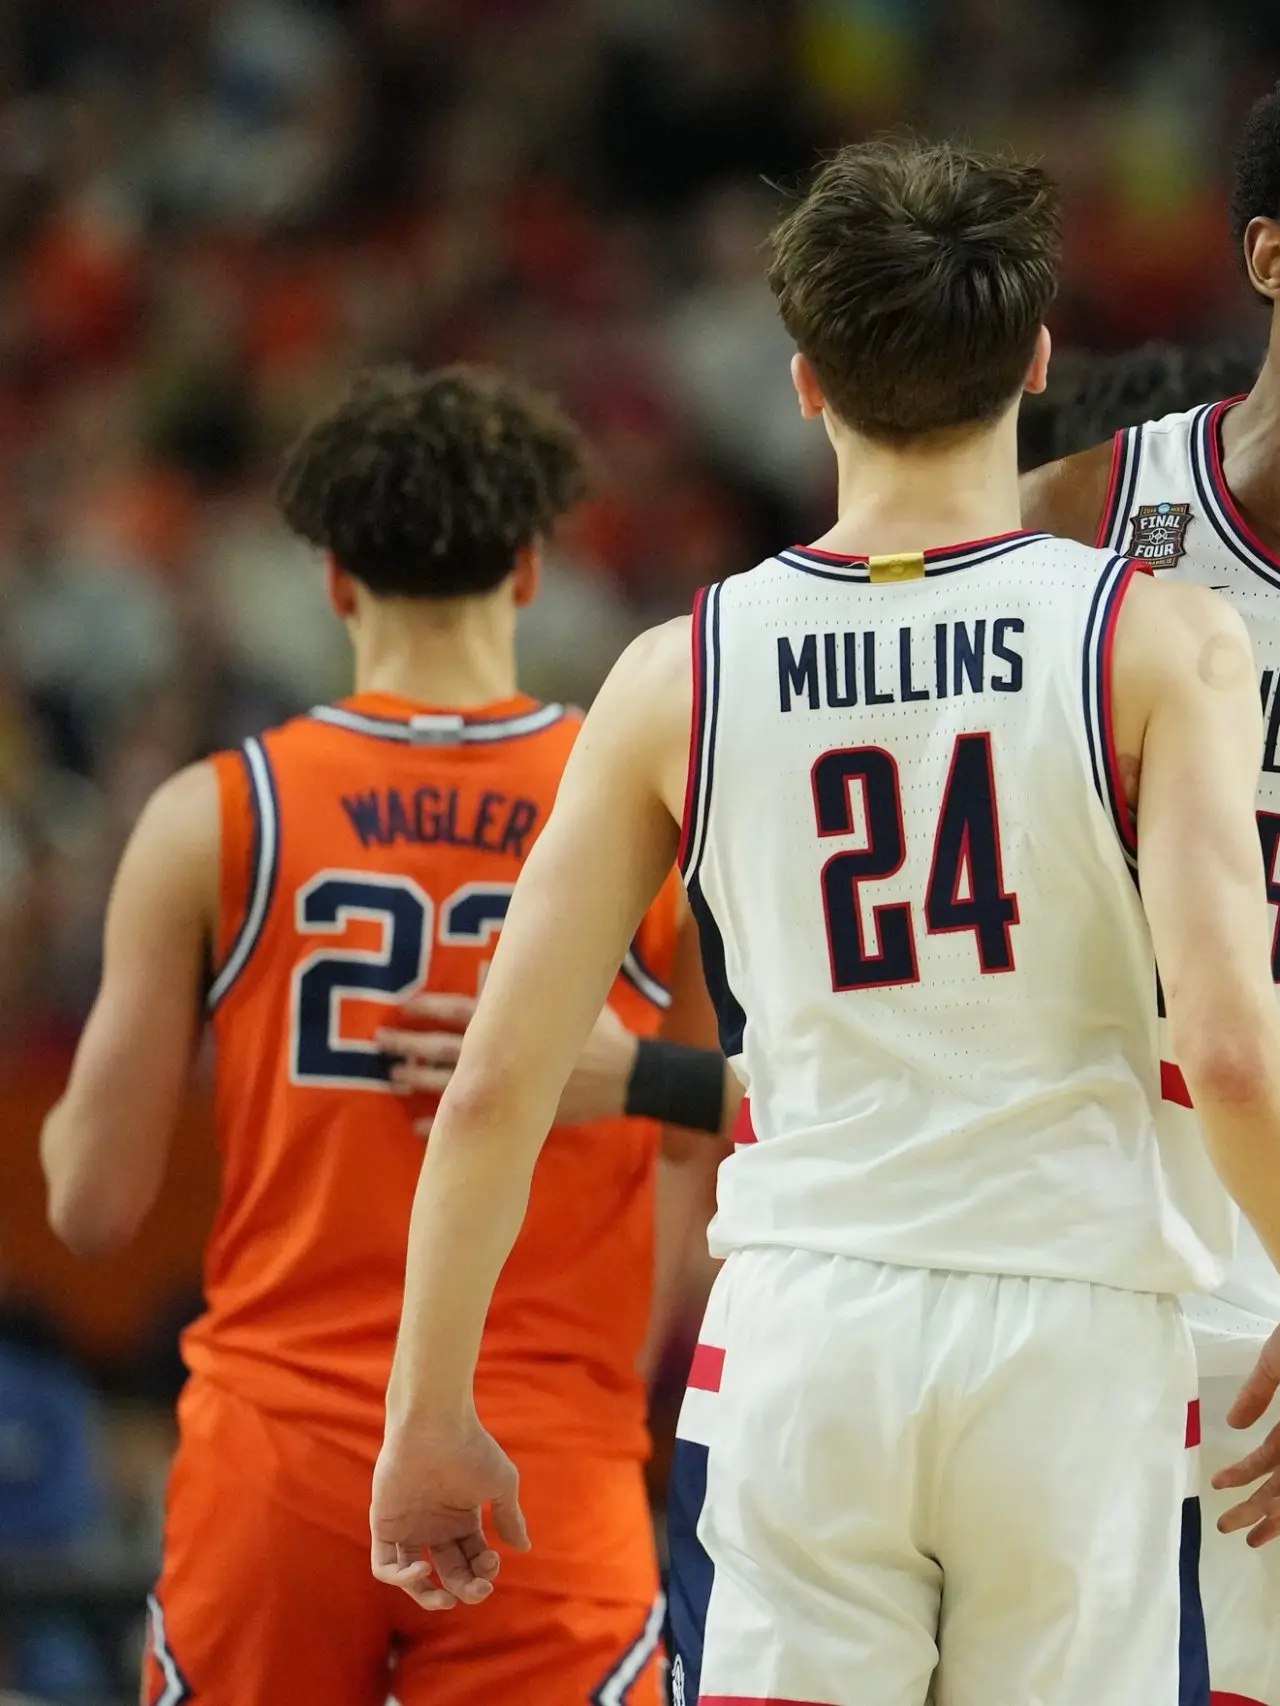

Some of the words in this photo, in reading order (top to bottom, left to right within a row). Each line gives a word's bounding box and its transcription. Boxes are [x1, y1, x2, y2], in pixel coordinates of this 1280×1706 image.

[1134, 542, 1174, 558] FOUR
[1140, 515, 1180, 530] FINAL
[777, 617, 1025, 713] MULLINS
[340, 785, 539, 859] WAGLER
[810, 731, 1020, 993] 24
